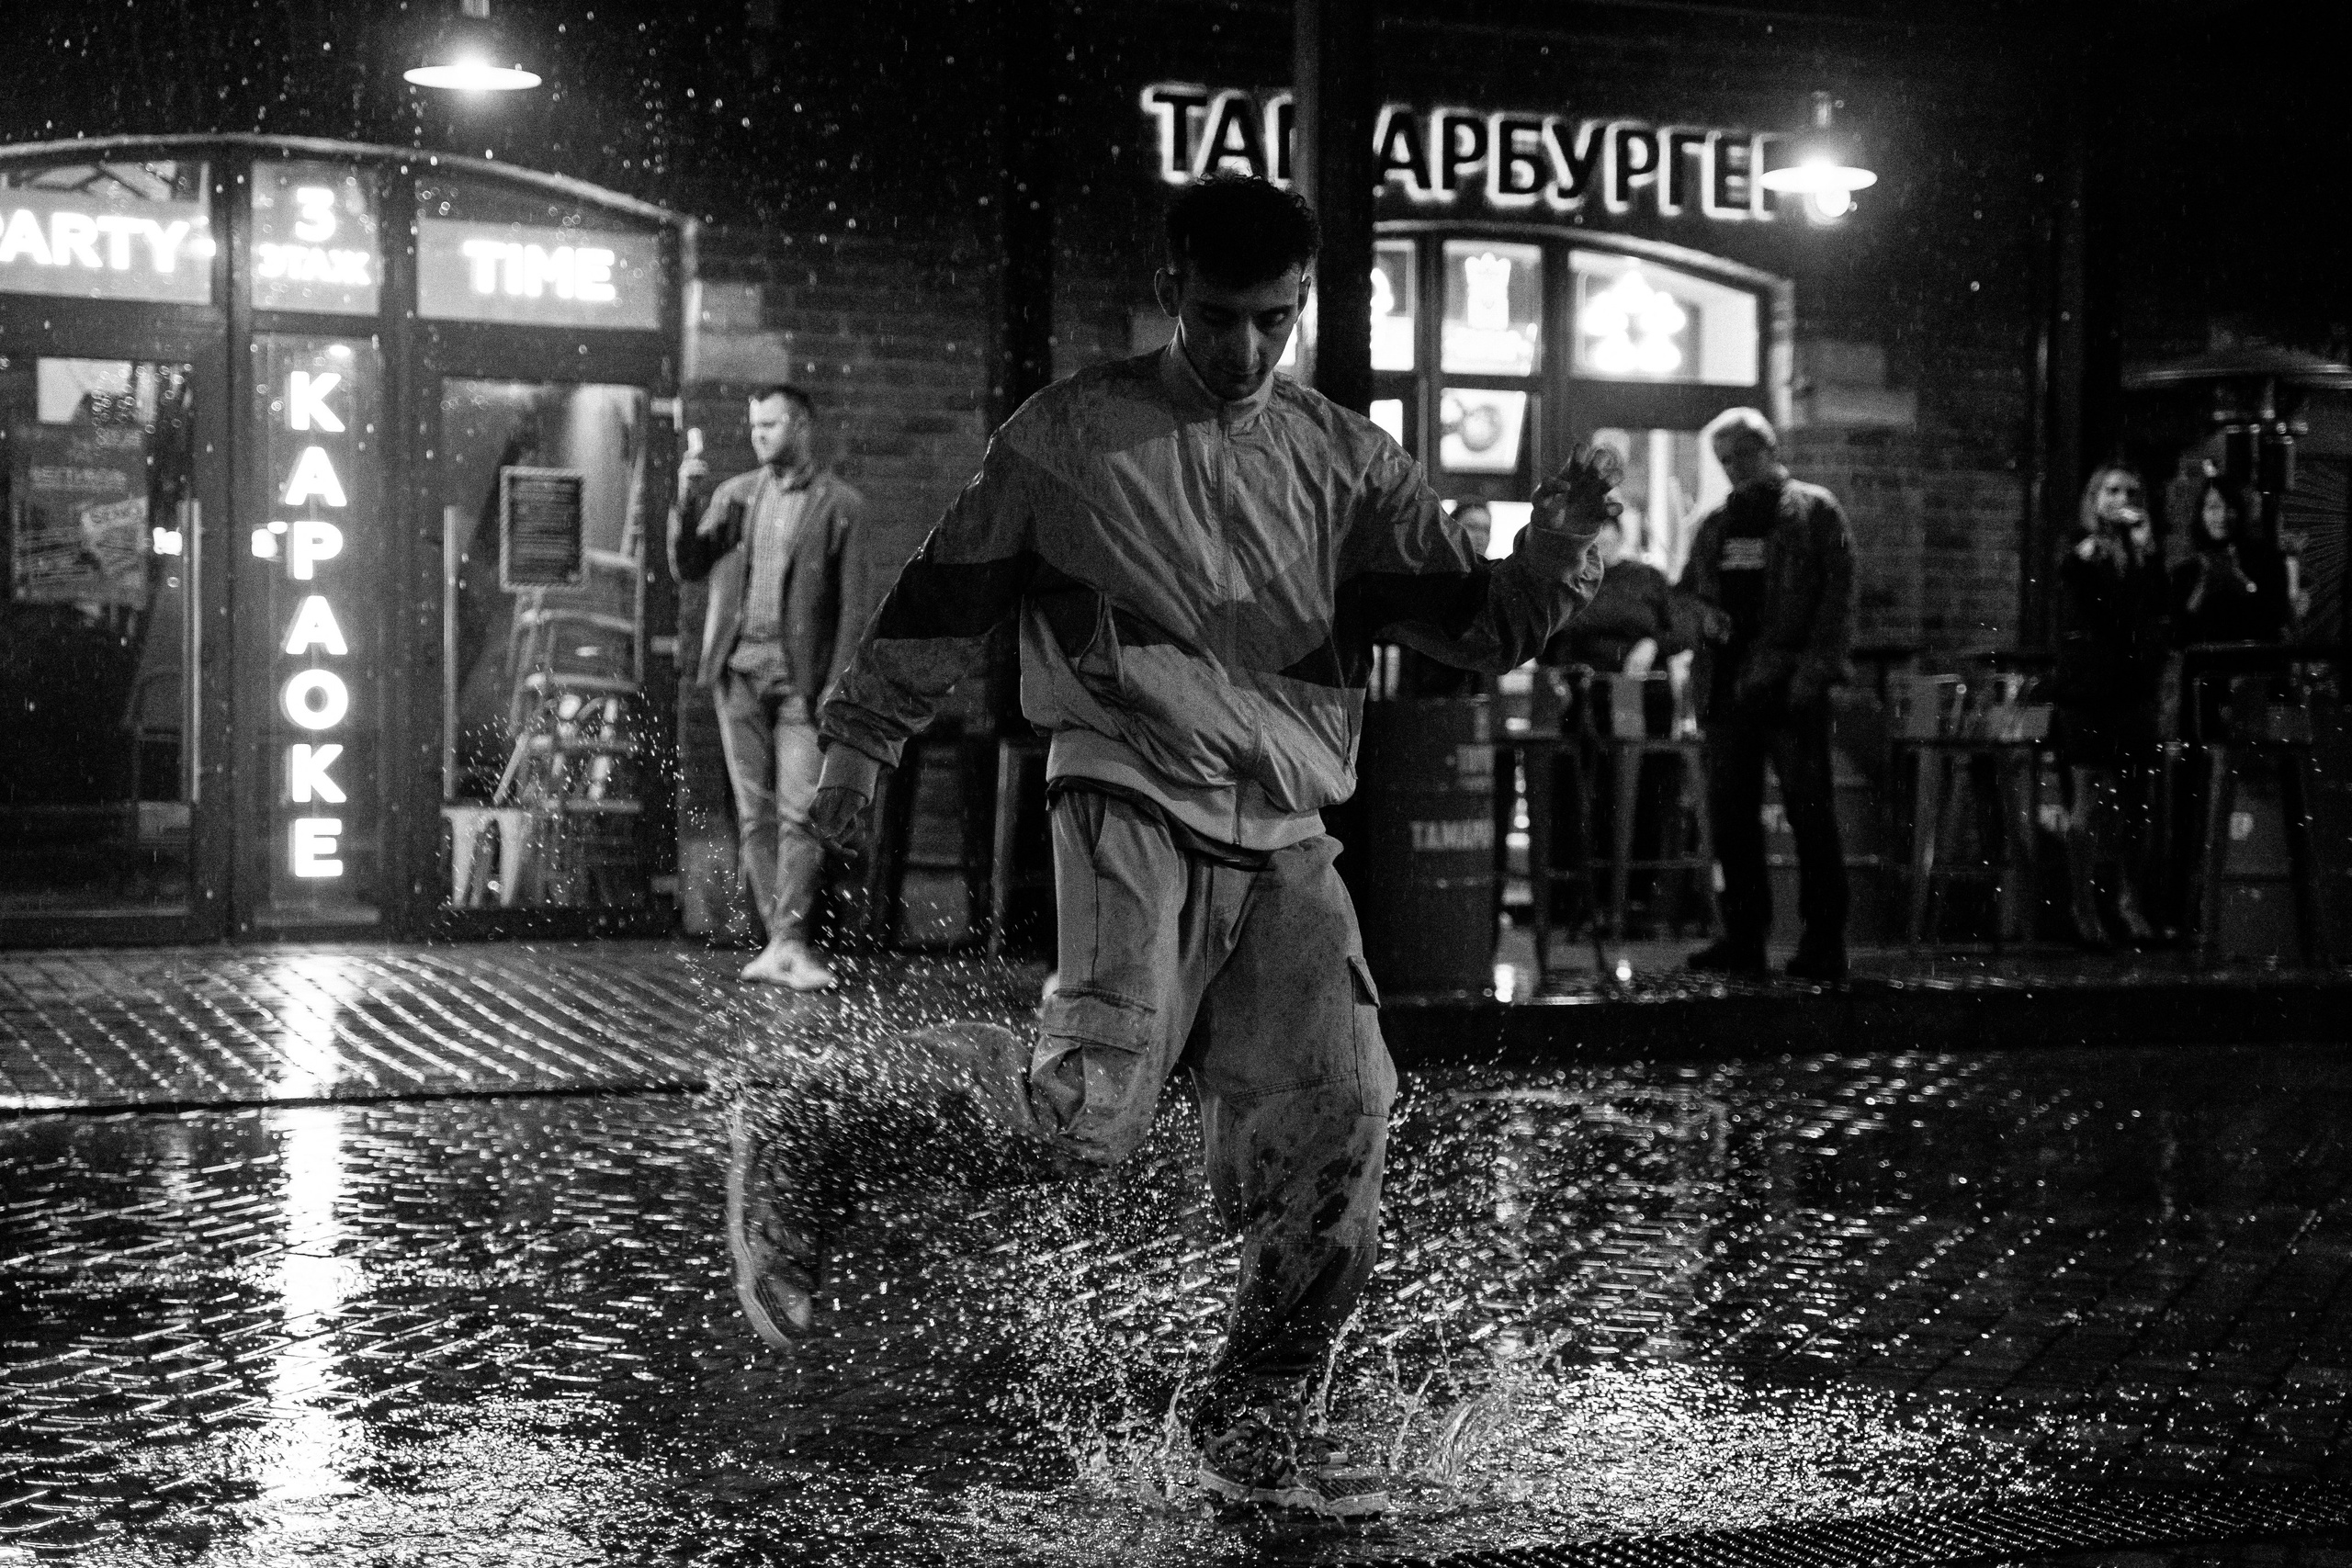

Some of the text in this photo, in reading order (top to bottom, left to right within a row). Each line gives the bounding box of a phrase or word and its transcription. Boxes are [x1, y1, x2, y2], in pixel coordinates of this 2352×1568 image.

[0, 209, 190, 273] ARTY
[295, 187, 336, 242] 3
[258, 243, 371, 286] ЭТАЖ
[463, 241, 616, 301] TIME
[285, 371, 349, 877] КАРАОКЕ
